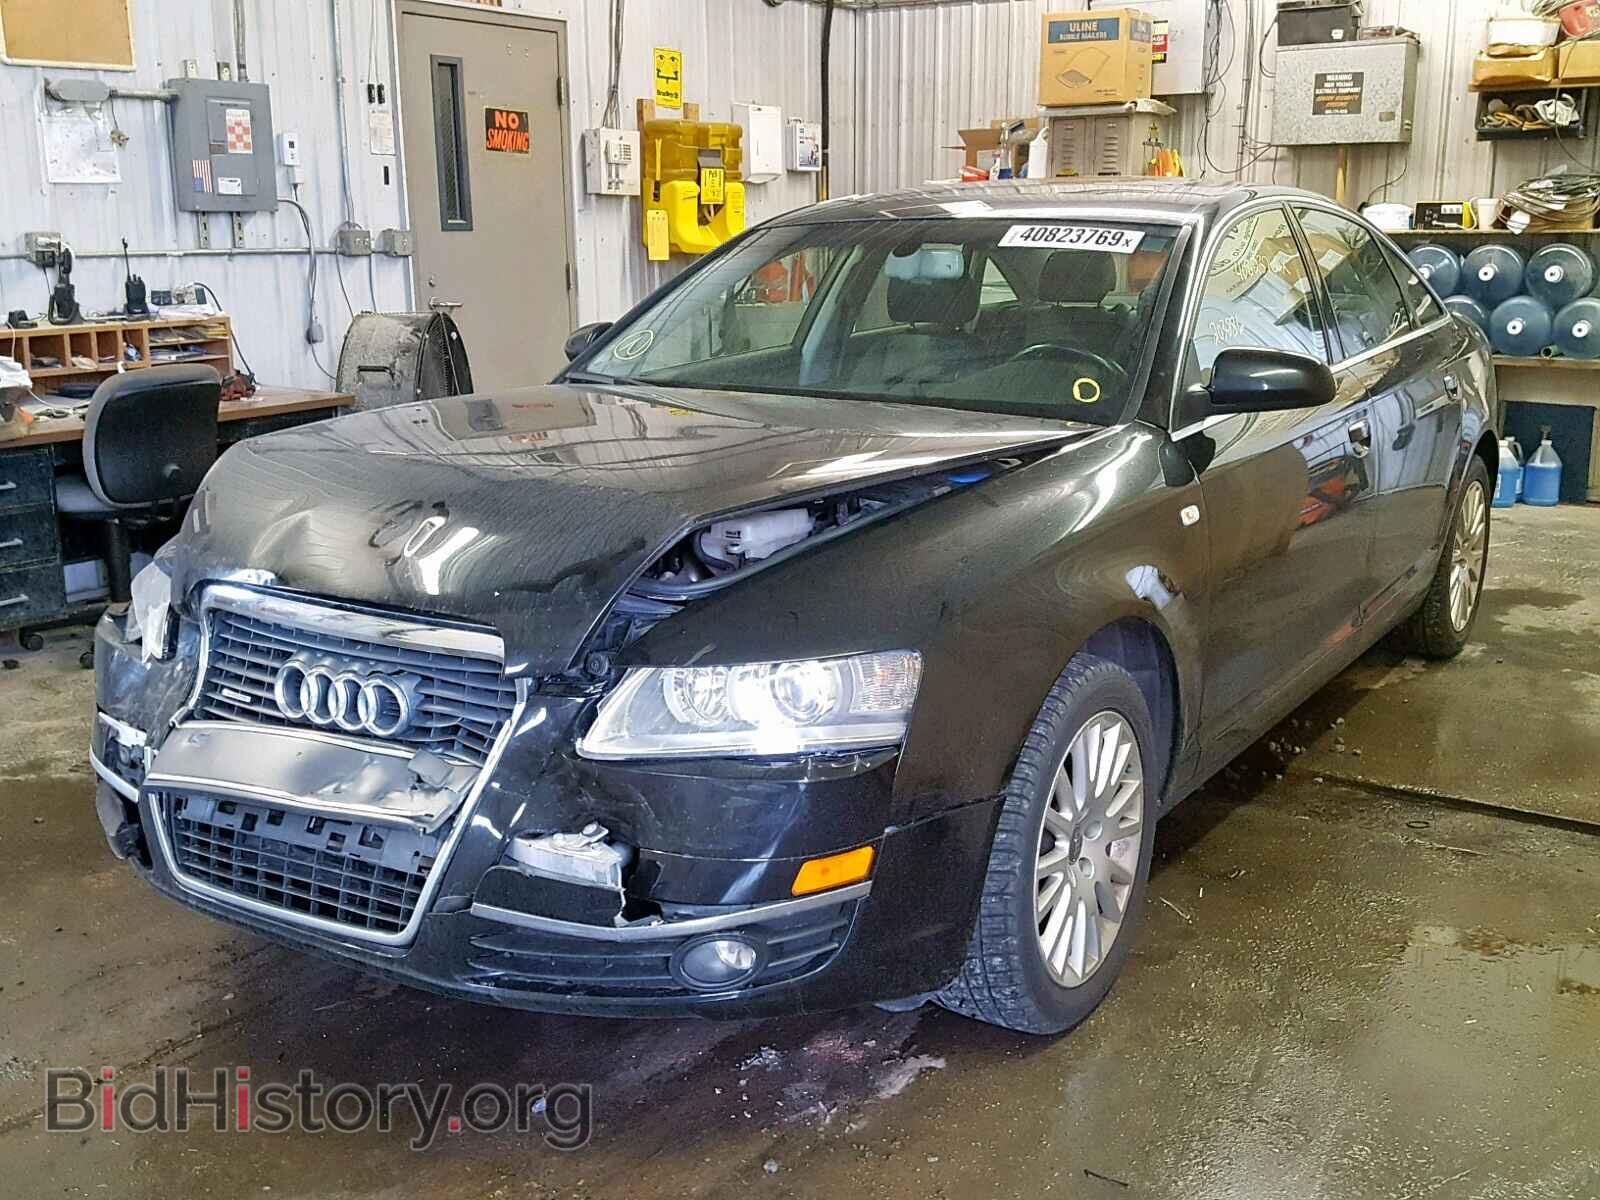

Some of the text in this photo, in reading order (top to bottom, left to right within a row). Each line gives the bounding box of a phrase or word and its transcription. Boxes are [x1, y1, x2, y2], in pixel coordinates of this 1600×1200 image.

[1069, 20, 1098, 33] ULINE
[495, 110, 520, 130] NO
[487, 128, 529, 152] SMOKING
